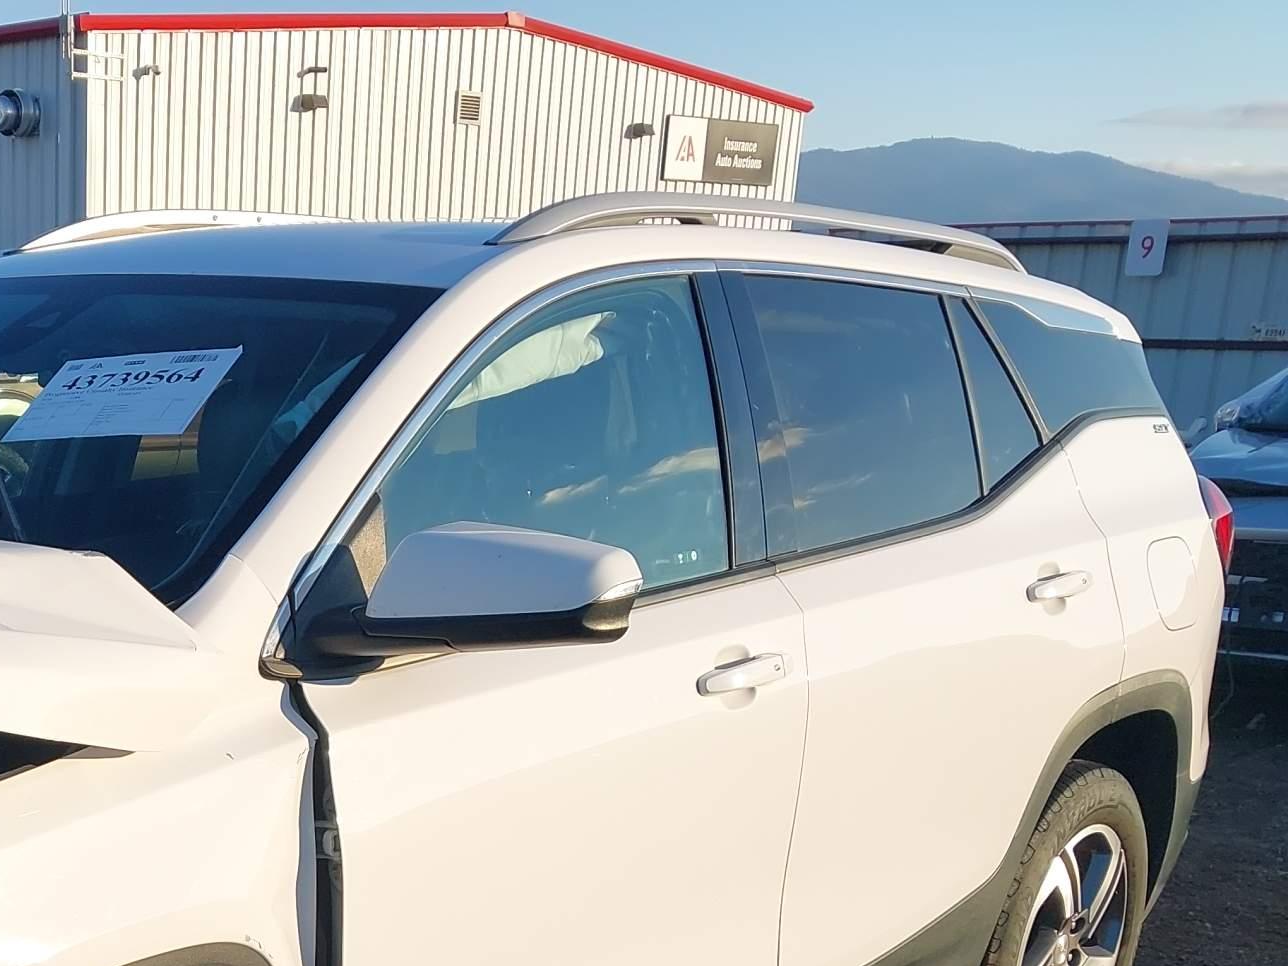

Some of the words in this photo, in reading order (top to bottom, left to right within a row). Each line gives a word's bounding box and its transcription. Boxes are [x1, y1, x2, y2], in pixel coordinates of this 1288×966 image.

[724, 136, 758, 152] Insurance
[715, 153, 732, 167] Auto
[732, 154, 763, 169] Auctions
[1141, 235, 1155, 259] 9
[62, 367, 205, 390] 43739564
